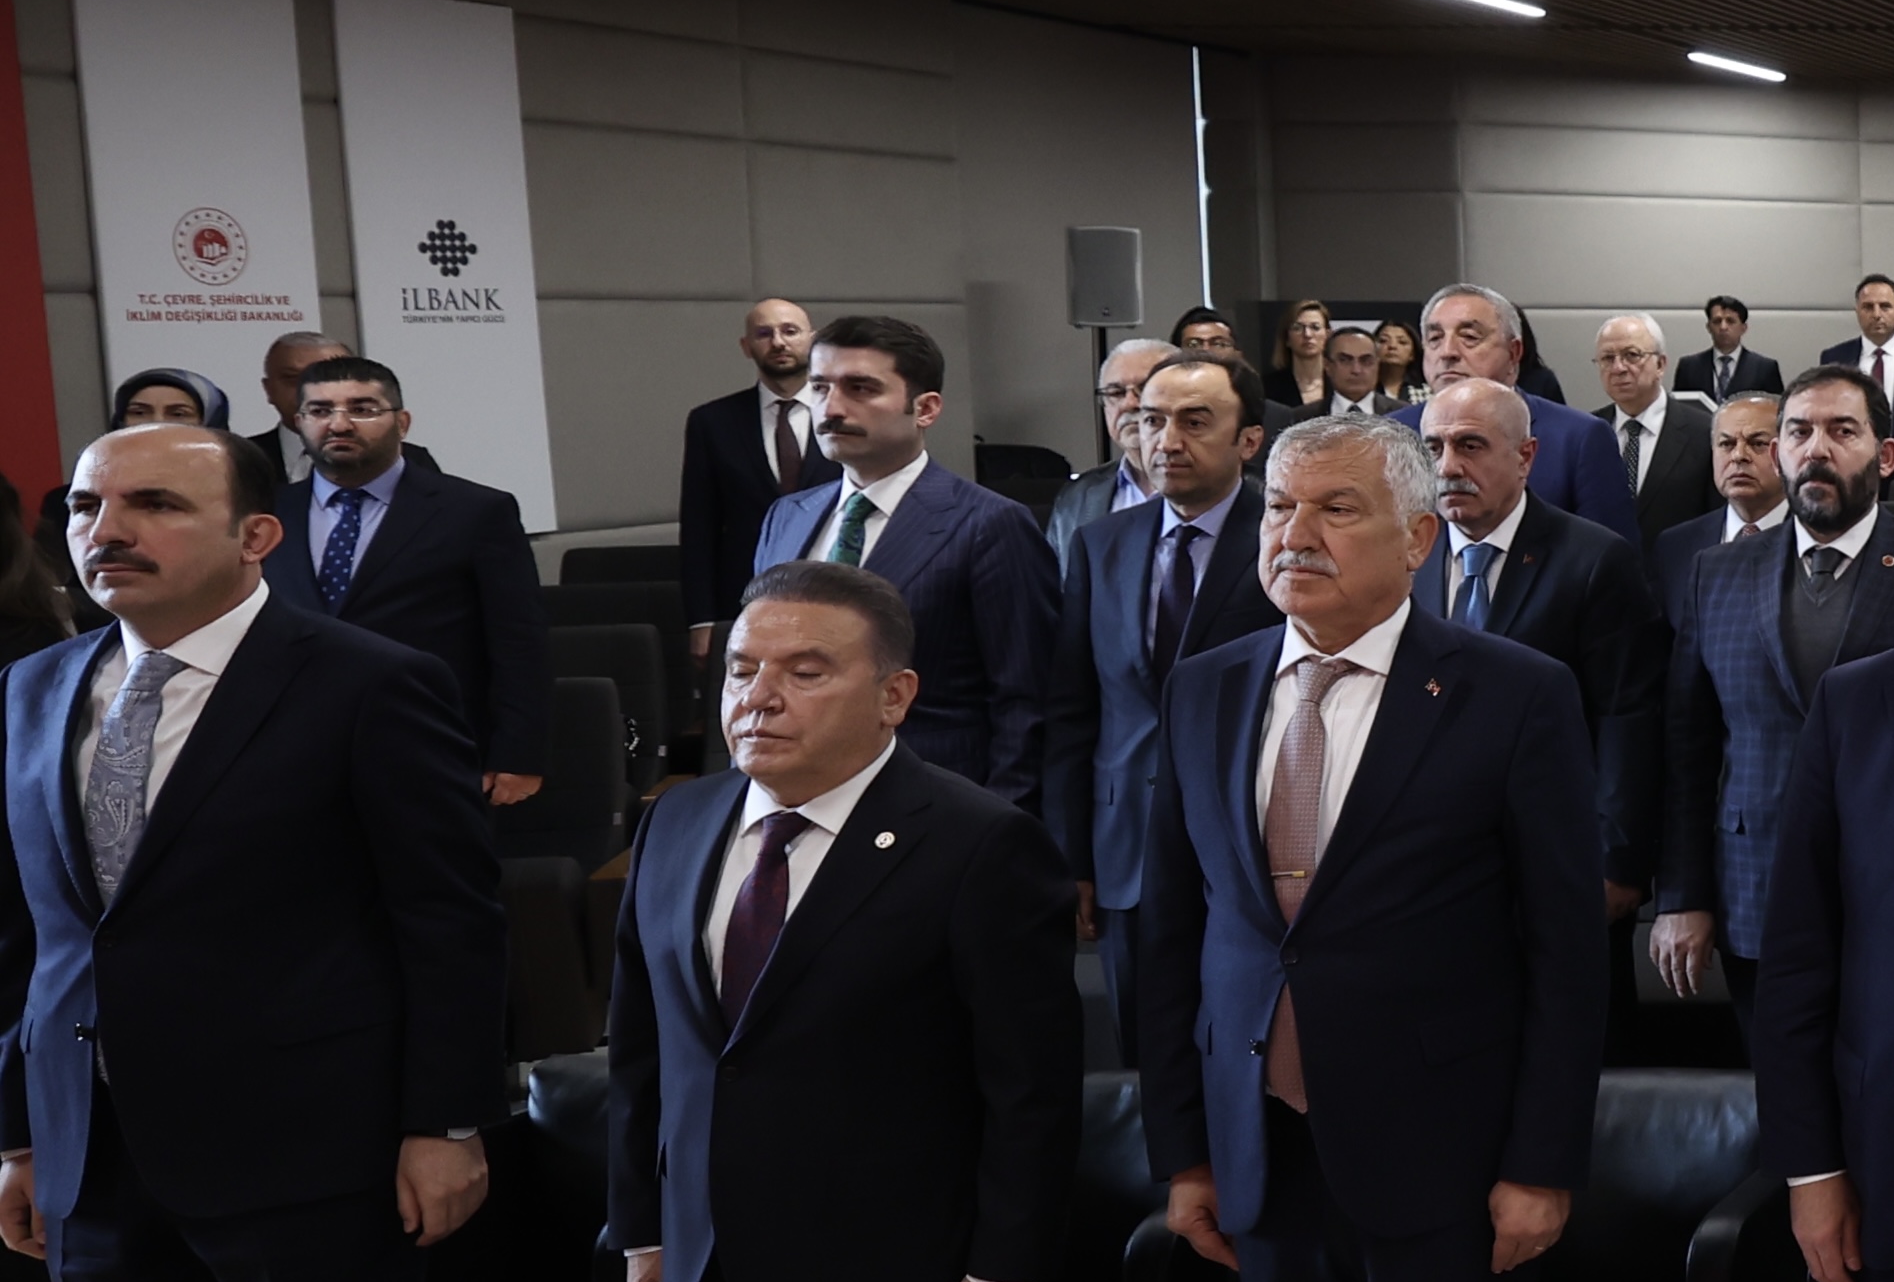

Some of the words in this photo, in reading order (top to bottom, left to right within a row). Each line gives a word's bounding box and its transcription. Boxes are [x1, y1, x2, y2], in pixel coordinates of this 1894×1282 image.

[137, 293, 160, 305] T.C.
[209, 292, 274, 307] ŞEHİRCİLİK
[276, 294, 291, 306] VE
[126, 308, 162, 322] İKLİM
[240, 308, 304, 322] BAKANLIĞI
